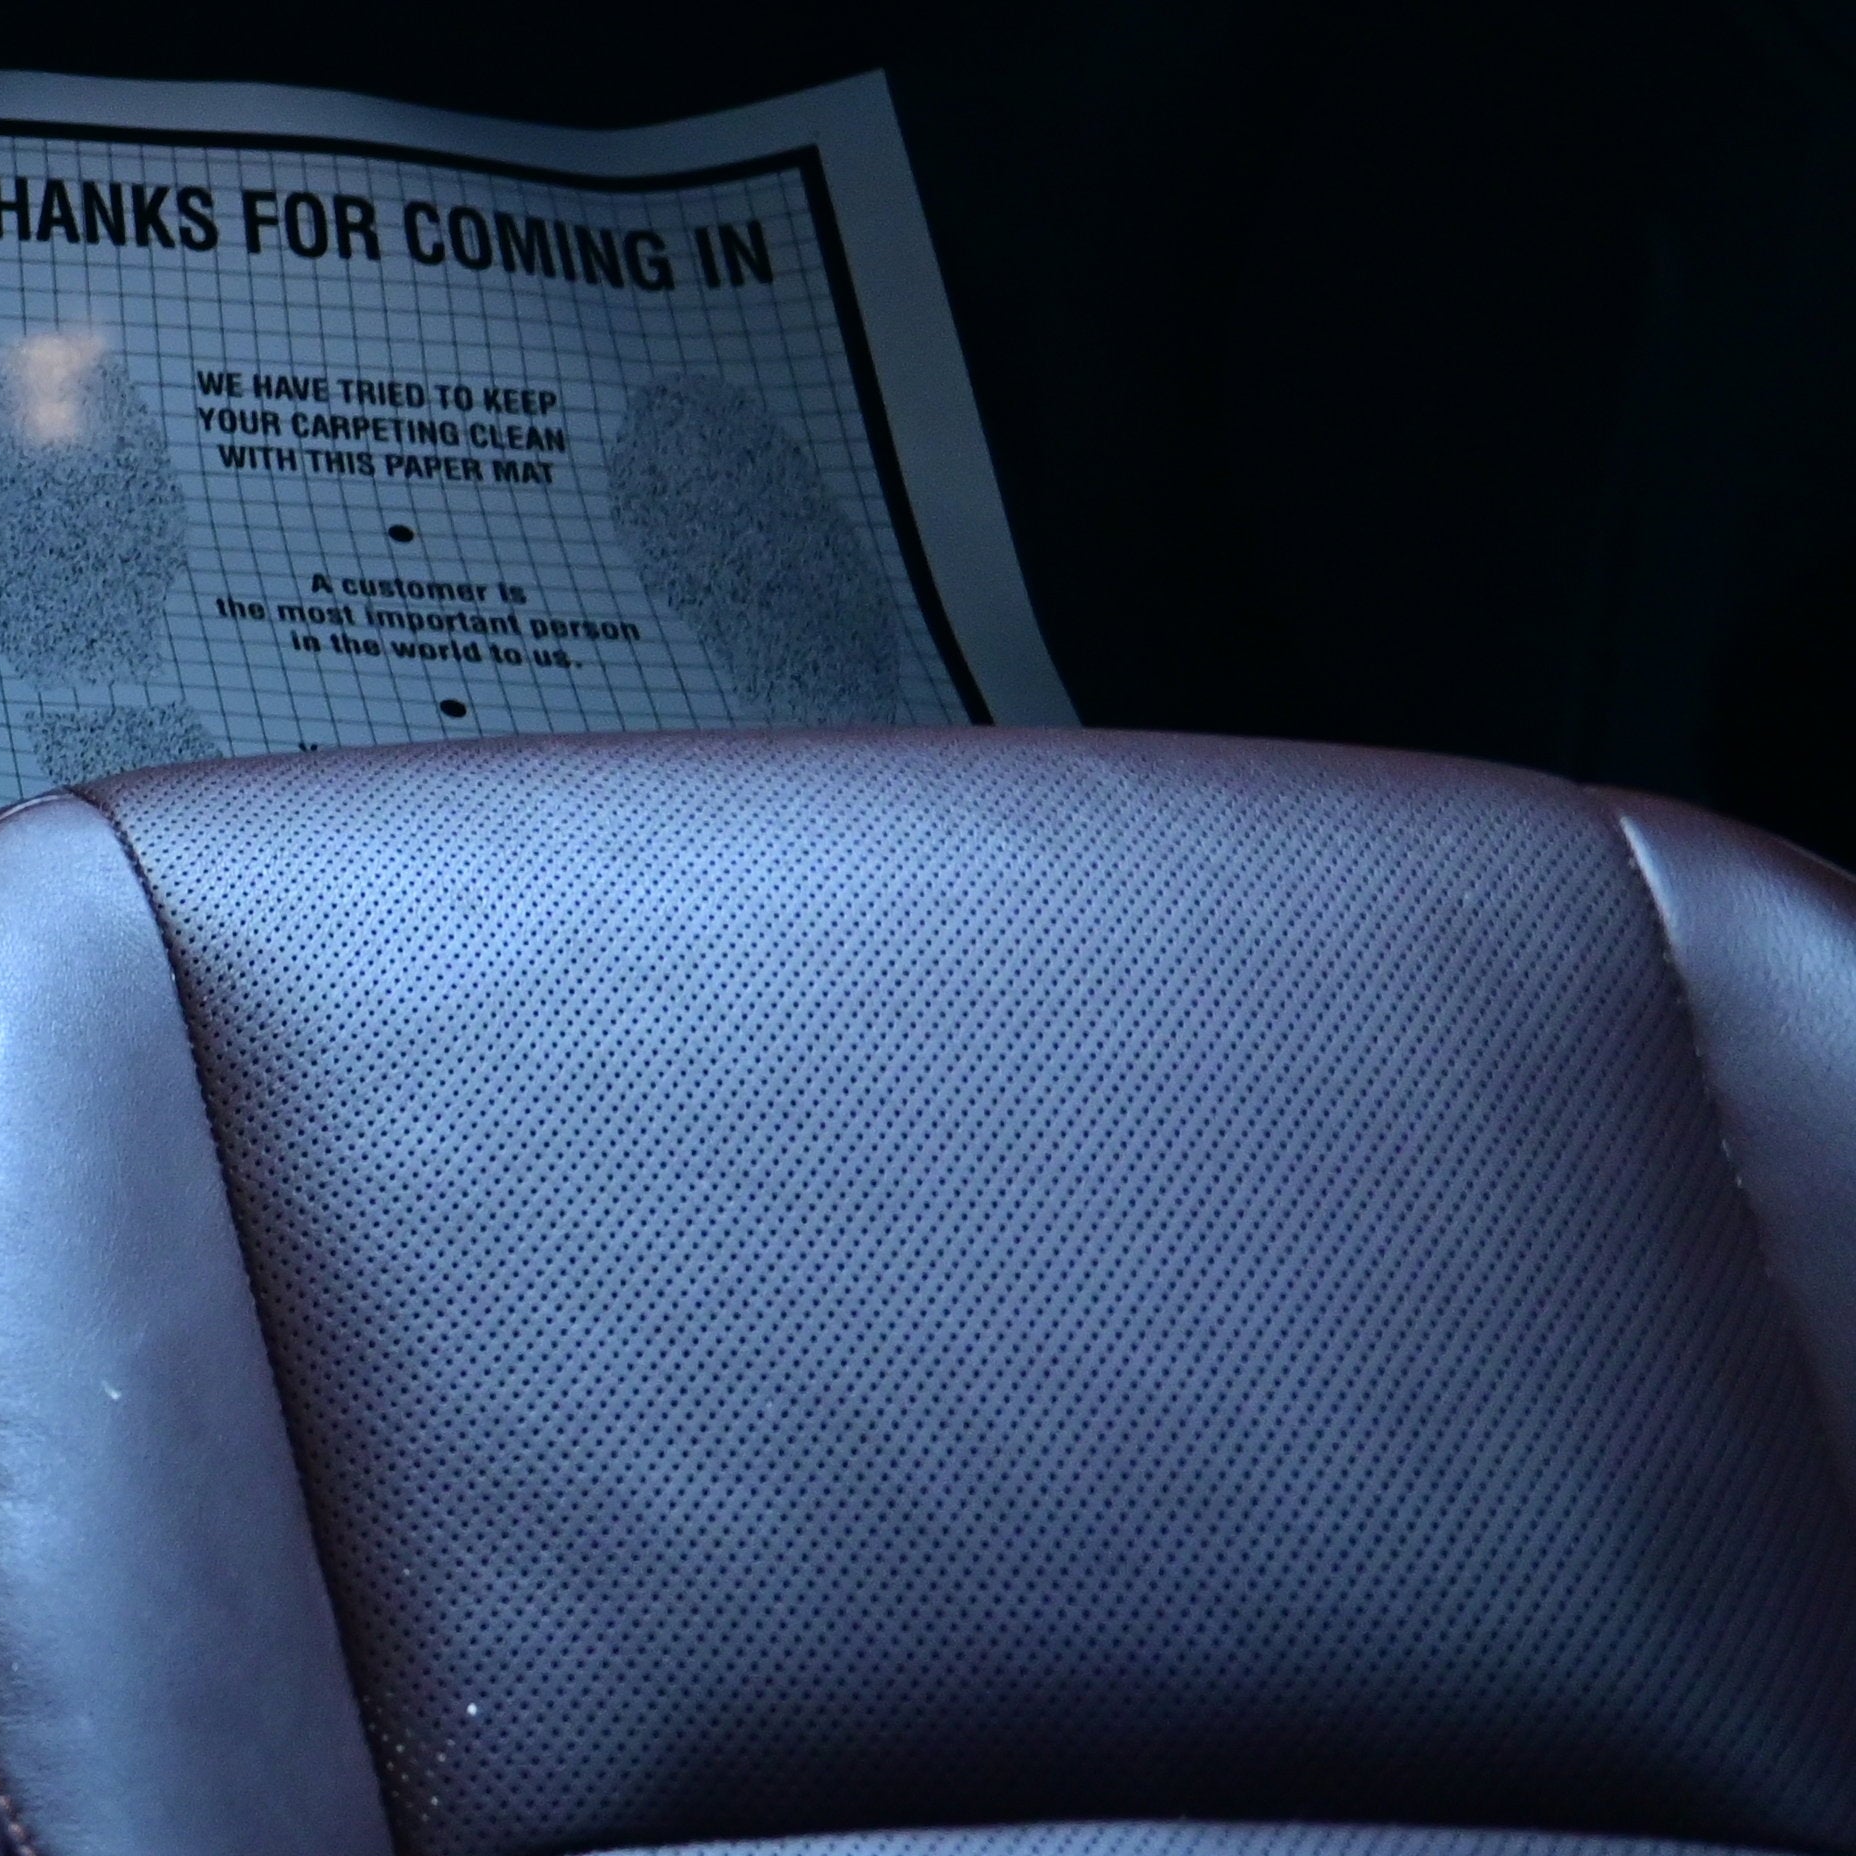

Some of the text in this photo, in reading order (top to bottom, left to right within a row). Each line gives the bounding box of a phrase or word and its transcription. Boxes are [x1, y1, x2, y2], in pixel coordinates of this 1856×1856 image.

[240, 189, 380, 262] FOR
[402, 200, 675, 292] COMING
[694, 219, 775, 286] IN
[196, 370, 557, 416] WE HAVE TRIED TO KEEP
[197, 407, 566, 452] YOUR CARPETING CLEAN
[217, 444, 554, 484] WITH THIS PAPER MAT
[310, 572, 527, 605] A customer is
[216, 597, 641, 642] the most important person
[290, 629, 584, 669] in the world to us.
